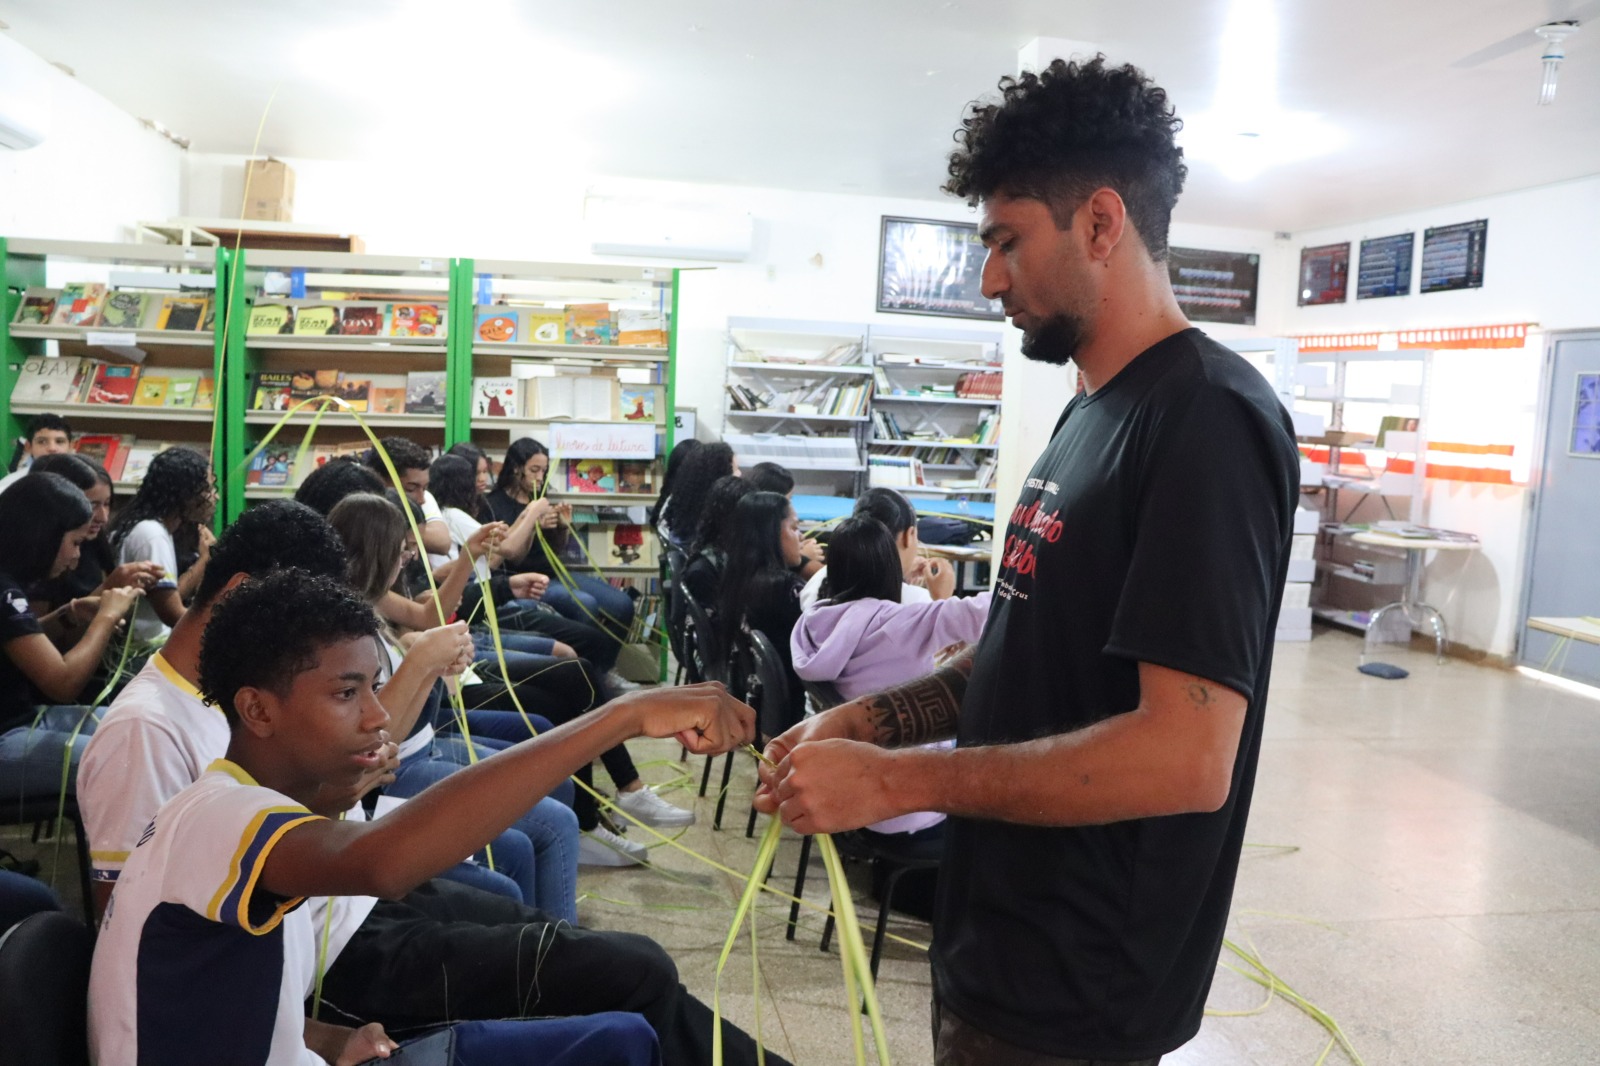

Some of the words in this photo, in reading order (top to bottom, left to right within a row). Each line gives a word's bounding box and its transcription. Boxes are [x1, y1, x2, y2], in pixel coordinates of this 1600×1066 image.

[25, 359, 75, 376] OBAX
[260, 373, 292, 382] BAILES
[592, 437, 604, 452] de
[607, 434, 648, 453] leitura
[1011, 588, 1029, 600] Cruz
